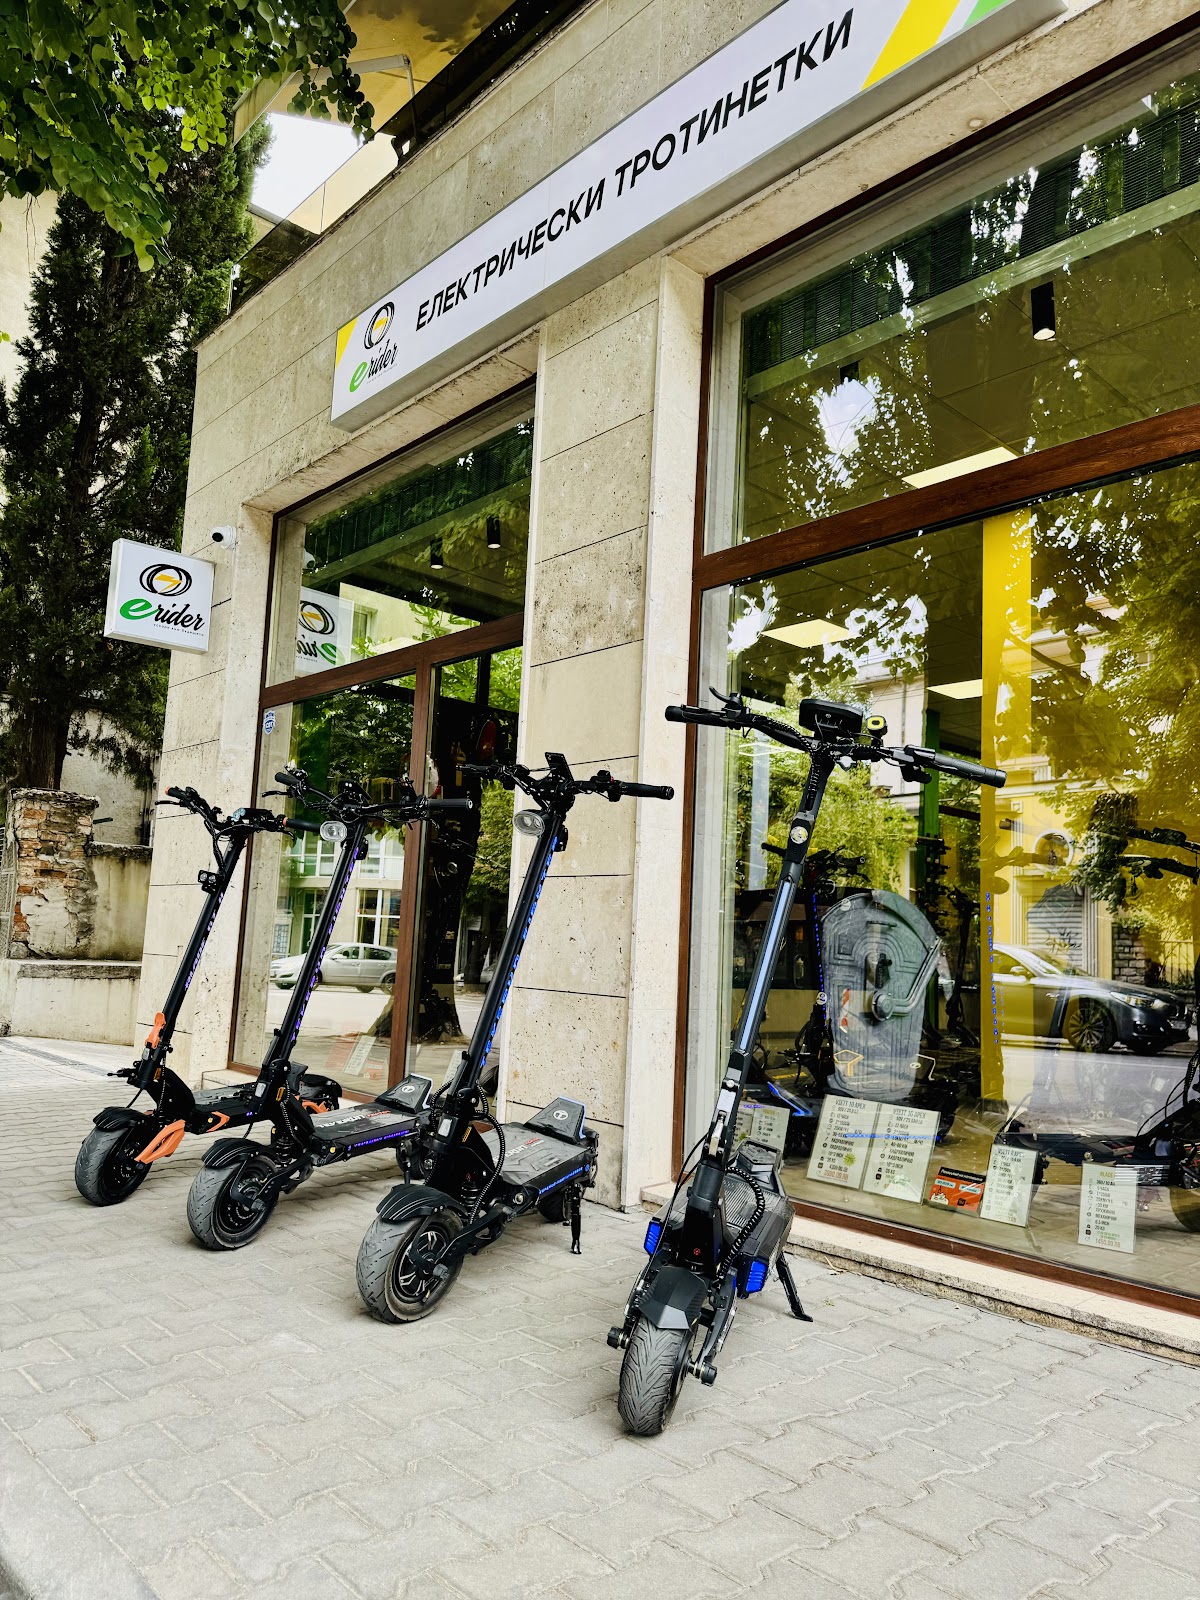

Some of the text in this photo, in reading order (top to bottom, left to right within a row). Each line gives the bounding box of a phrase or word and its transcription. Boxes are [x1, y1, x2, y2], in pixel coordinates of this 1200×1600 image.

[415, 8, 853, 332] ЕЛЕКТРИЧЕСКИ ТРОТИНЕТКИ
[349, 340, 398, 393] erider
[119, 598, 205, 631] erider
